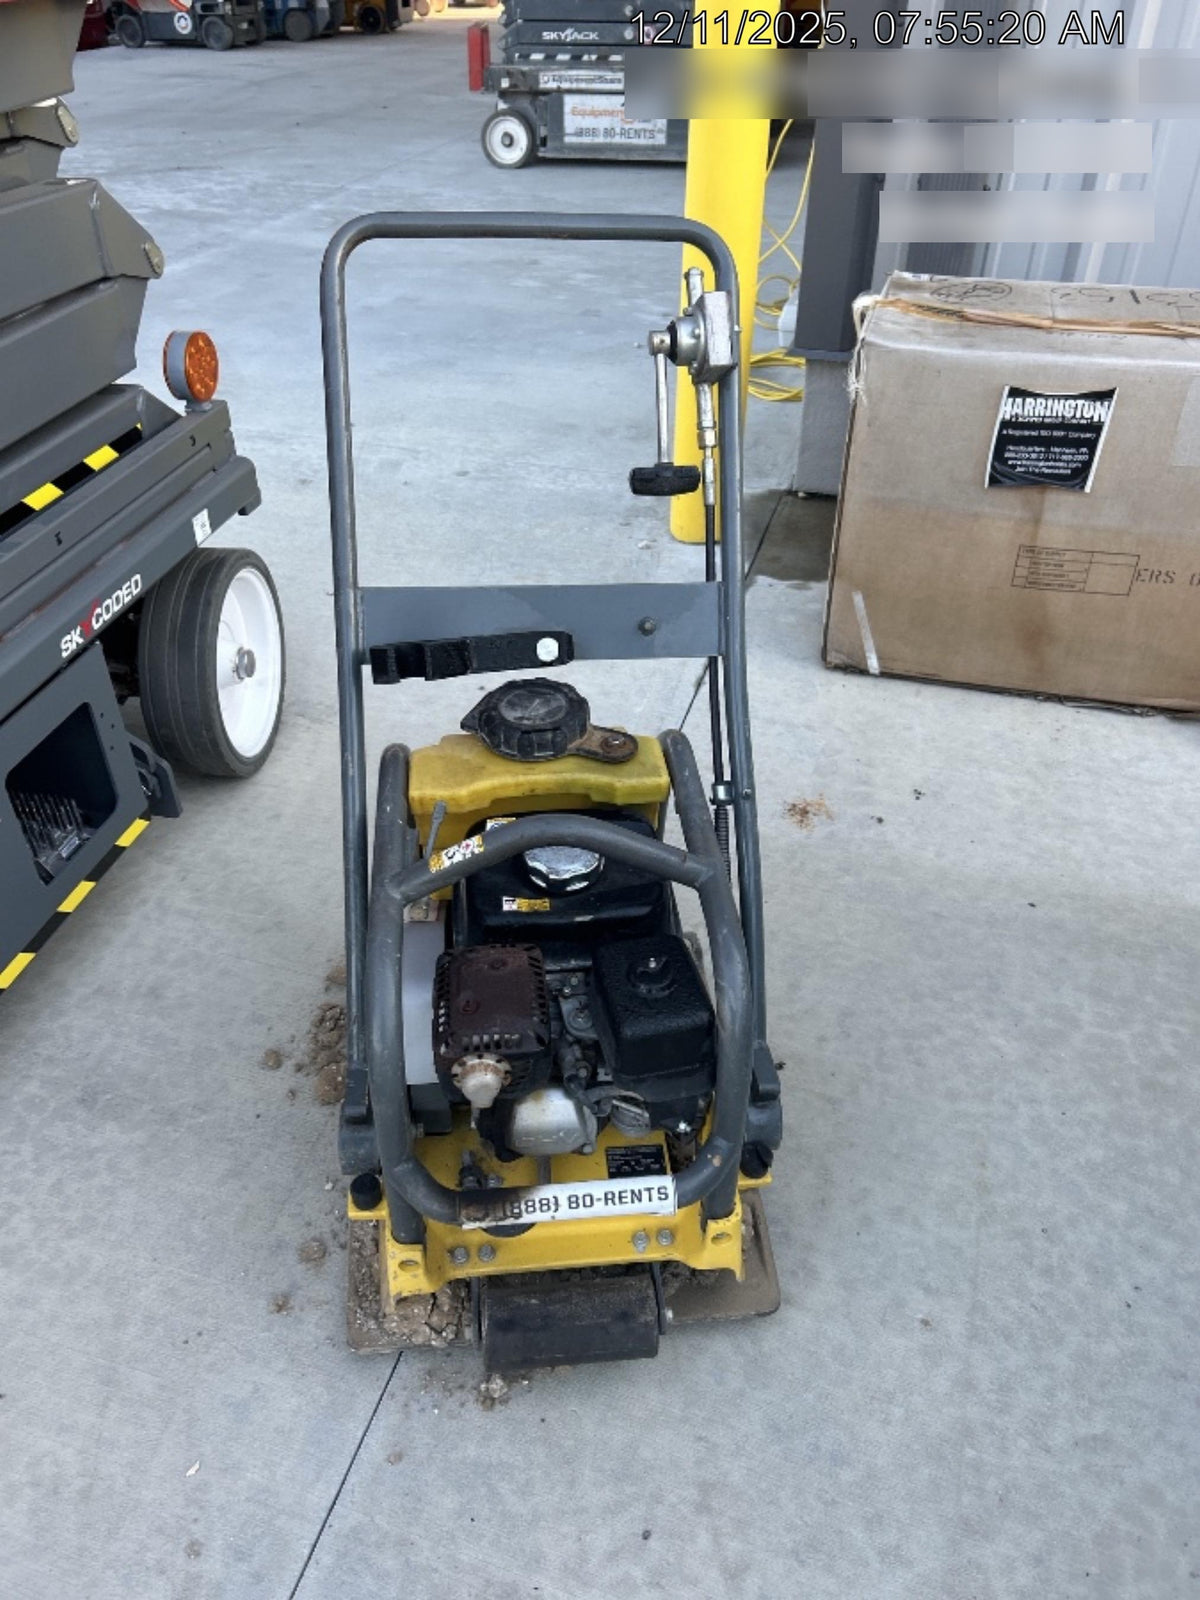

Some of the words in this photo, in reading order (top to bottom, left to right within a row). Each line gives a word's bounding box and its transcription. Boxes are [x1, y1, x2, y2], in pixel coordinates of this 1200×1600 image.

[541, 27, 599, 41] SKYJACK
[999, 397, 1110, 422] HARRINGTON
[60, 573, 142, 658] SKYCODED
[567, 1185, 670, 1210] 80-RENTS
